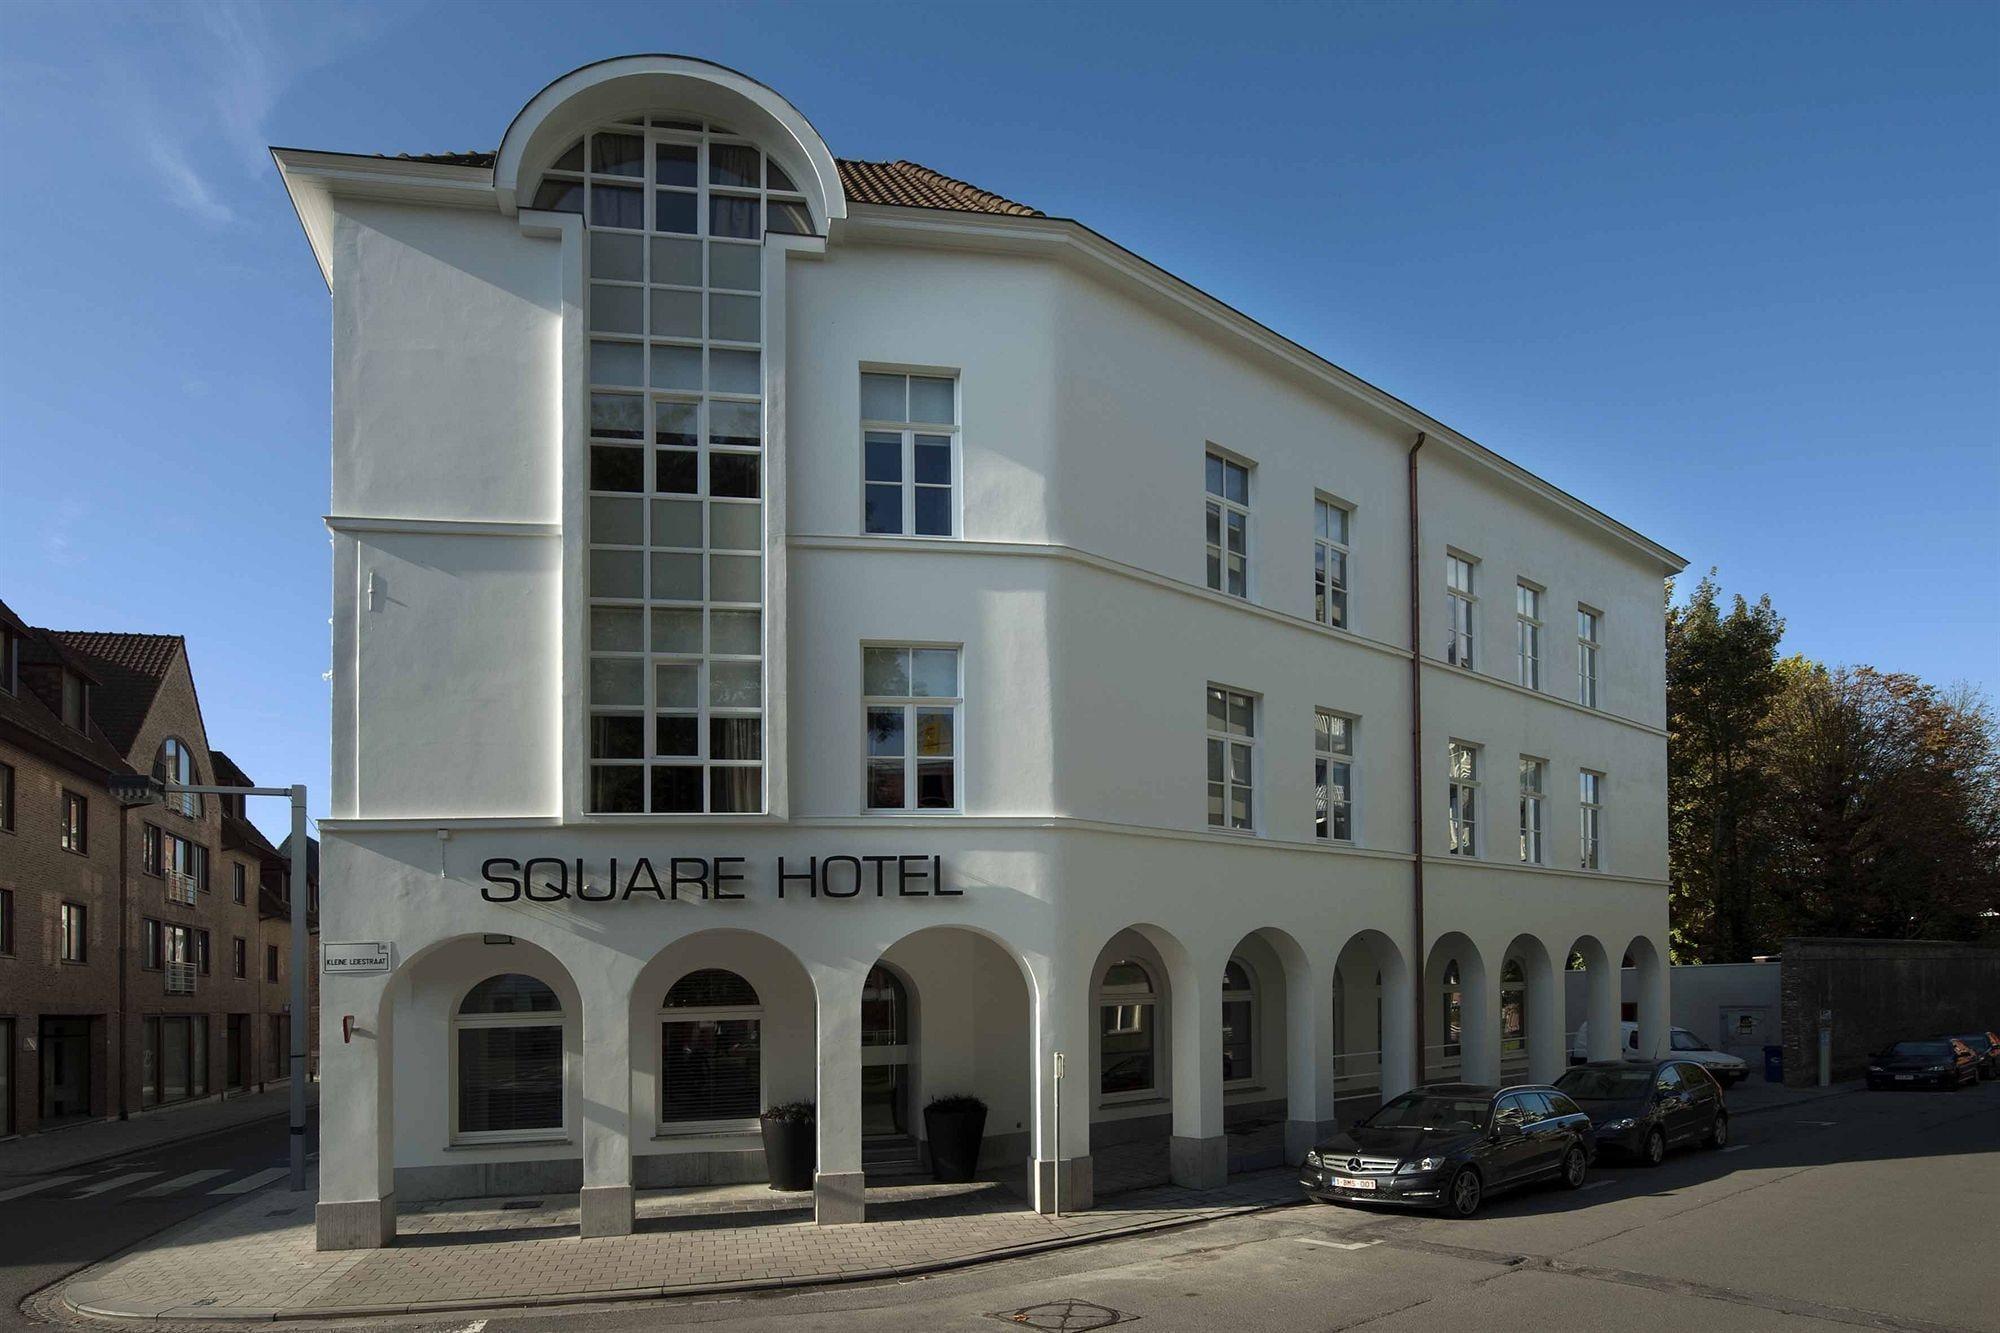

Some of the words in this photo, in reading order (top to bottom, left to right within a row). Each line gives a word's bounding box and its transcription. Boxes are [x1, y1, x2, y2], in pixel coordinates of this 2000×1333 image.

[481, 857, 745, 902] SQUARE
[778, 855, 964, 898] HOTEL
[326, 958, 348, 966] KLEINE
